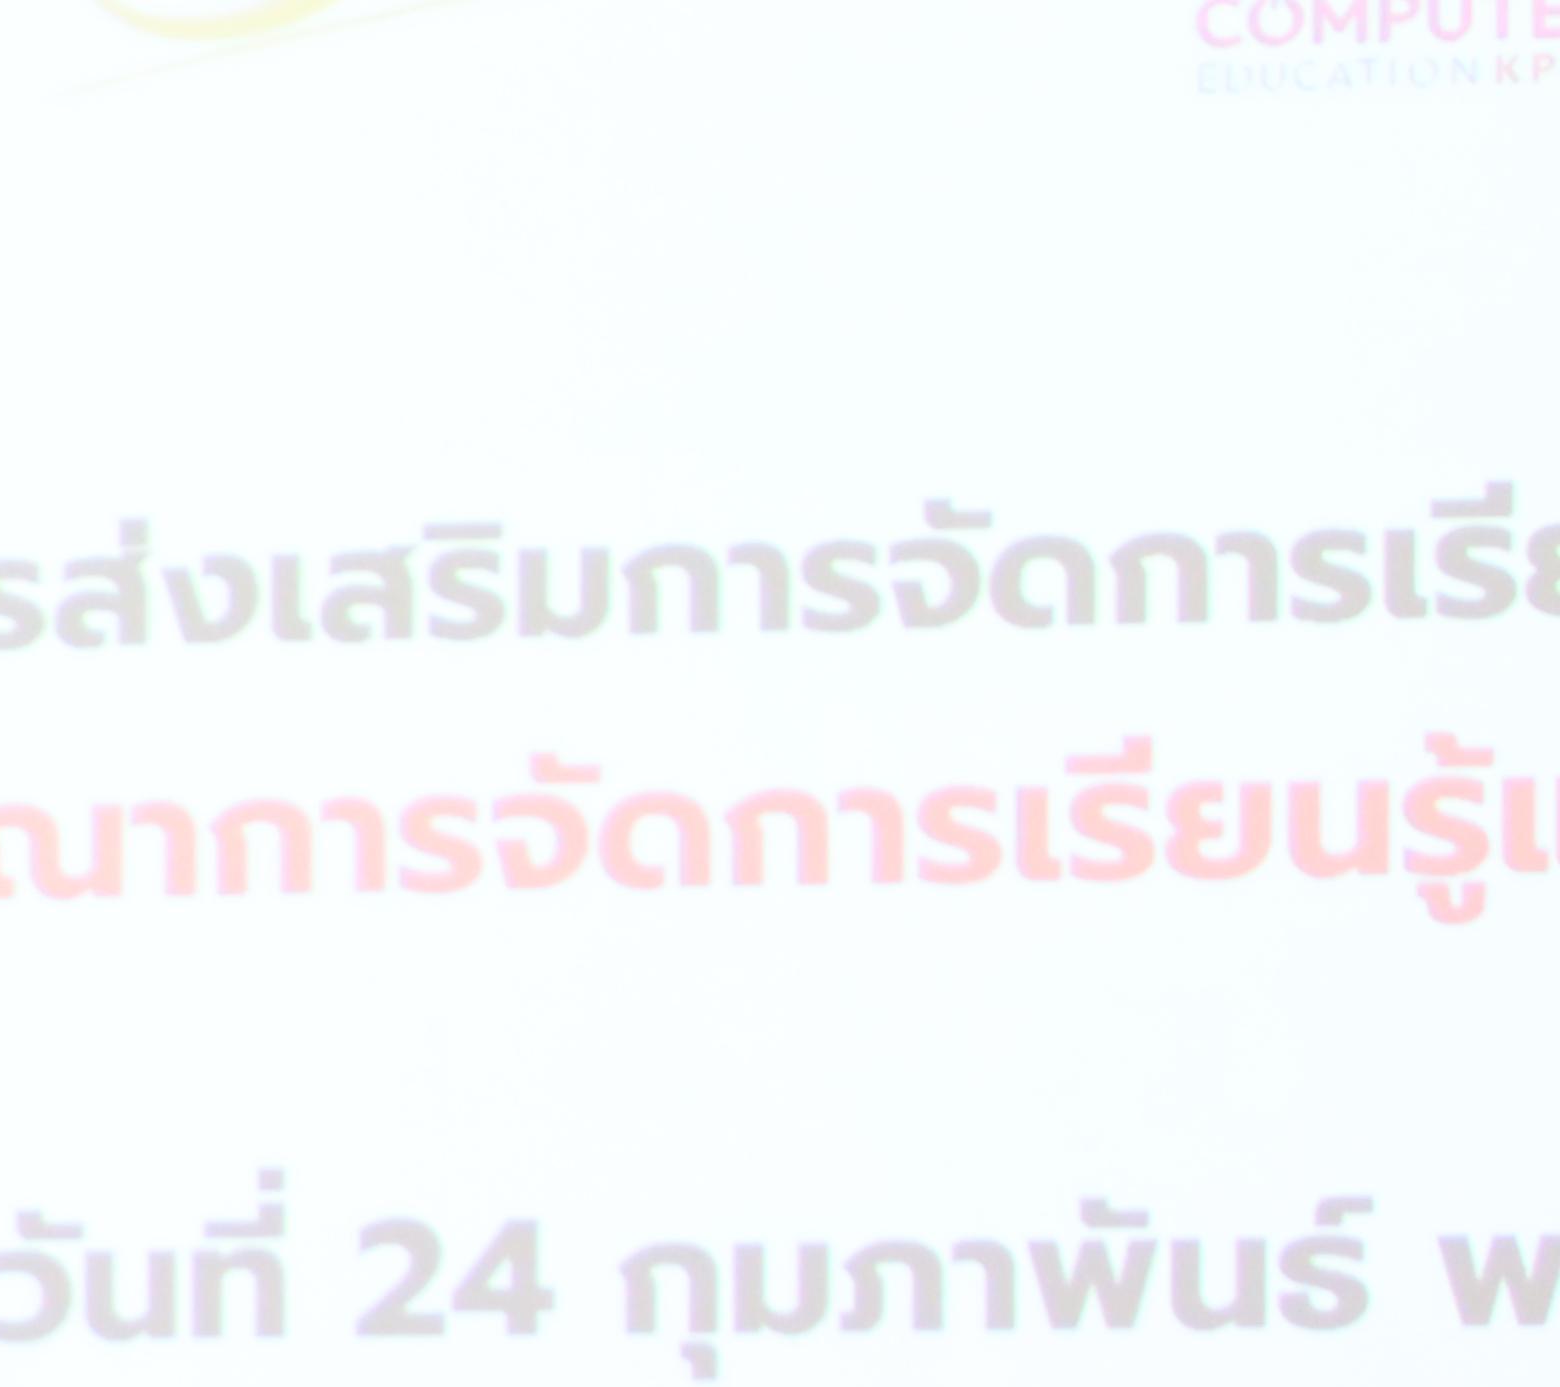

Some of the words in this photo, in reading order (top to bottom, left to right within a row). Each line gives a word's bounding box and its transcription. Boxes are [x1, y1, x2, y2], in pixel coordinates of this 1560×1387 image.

[1196, 57, 1480, 94] EDUCATION
[356, 1218, 556, 1338] 24
[620, 1196, 1377, 1382] กุมภาพันธ์
